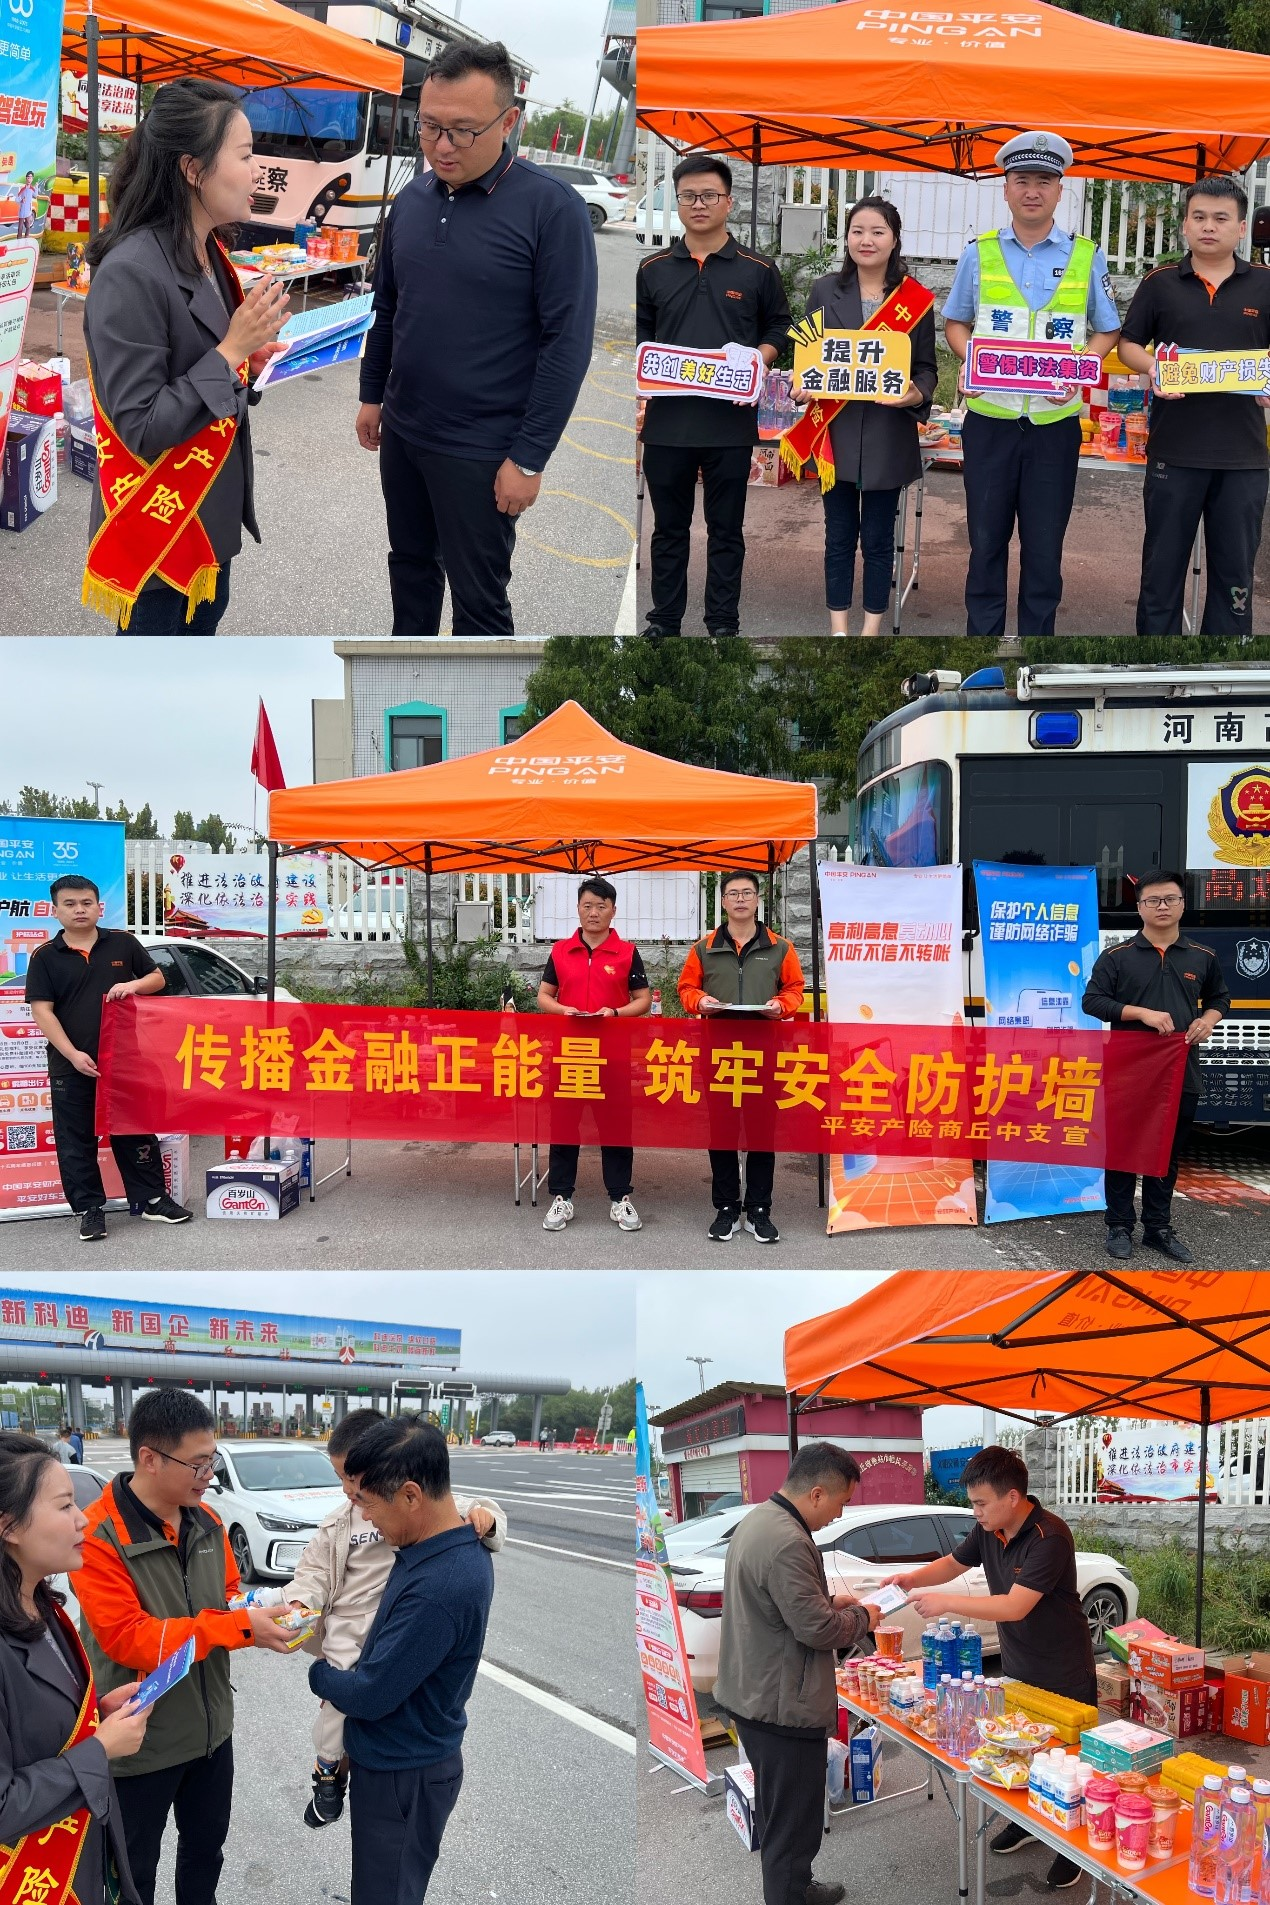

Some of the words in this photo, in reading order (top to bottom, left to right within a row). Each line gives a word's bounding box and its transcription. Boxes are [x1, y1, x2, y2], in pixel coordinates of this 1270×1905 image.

[863, 9, 1043, 25] 中国平安
[822, 338, 886, 365] 提升
[642, 351, 753, 393] 共创美好生活
[978, 353, 1099, 381] 警惕非法集资
[800, 367, 905, 395] 金融服务
[1163, 711, 1270, 744] 河南
[495, 755, 627, 765] 中国平安
[53, 841, 79, 859] 35
[180, 872, 318, 889] 推进法治政建设
[180, 891, 318, 908] 深化依法治实践
[990, 901, 1080, 921] 保护个人信息
[989, 922, 1079, 942] 谨防网络诈骗
[175, 1023, 607, 1100] 传播金融正能量
[644, 1038, 1103, 1123] 筑牢安全防护墙
[821, 1115, 1052, 1144] 平安产险商丘中支
[1061, 1125, 1091, 1147] 宣
[221, 1198, 265, 1210] Ganten
[228, 1189, 255, 1199] 百岁山
[0, 1299, 90, 1330] 新科迪
[111, 1308, 189, 1338] 新国企
[209, 1316, 279, 1344] 新未来
